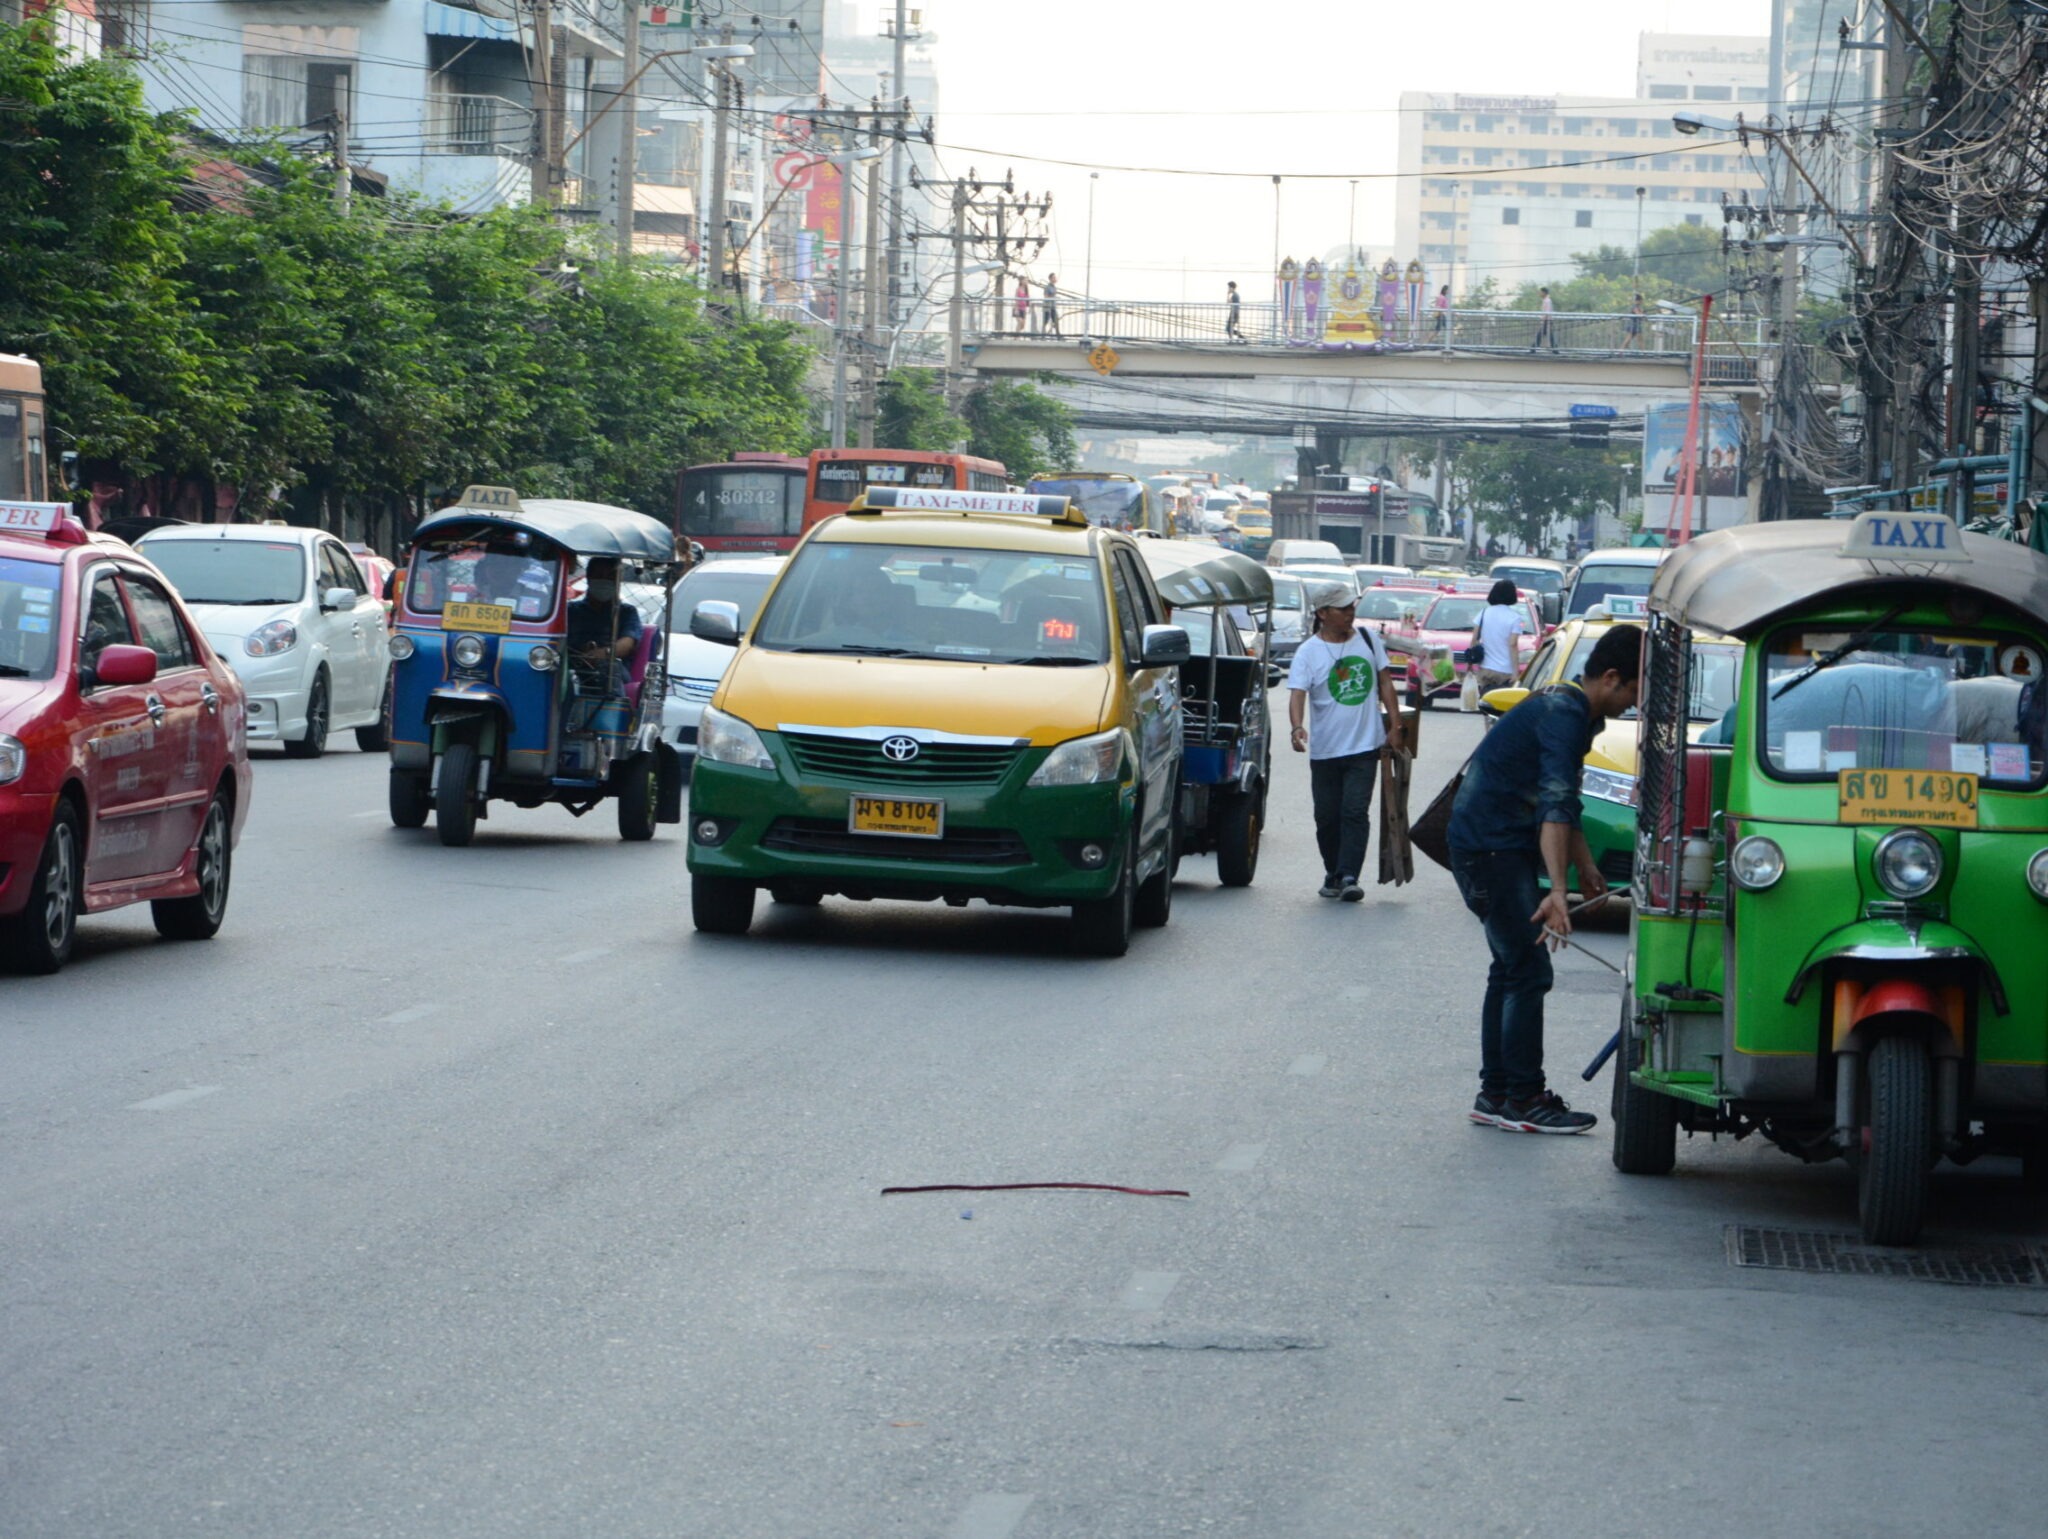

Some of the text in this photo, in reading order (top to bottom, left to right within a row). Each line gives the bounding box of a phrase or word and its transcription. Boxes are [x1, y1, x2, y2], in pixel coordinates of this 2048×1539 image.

[875, 467, 897, 480] 77
[470, 489, 511, 505] TAXI
[696, 490, 706, 505] 4
[900, 492, 1036, 513] TAXI-METER
[1868, 518, 1947, 549] TAXI
[476, 606, 508, 621] 6504
[1043, 618, 1074, 639] ว่าง
[1904, 774, 1973, 803] 1490
[892, 801, 937, 821] 8104
[1860, 807, 1957, 822] กรุงเทพมหานคร
